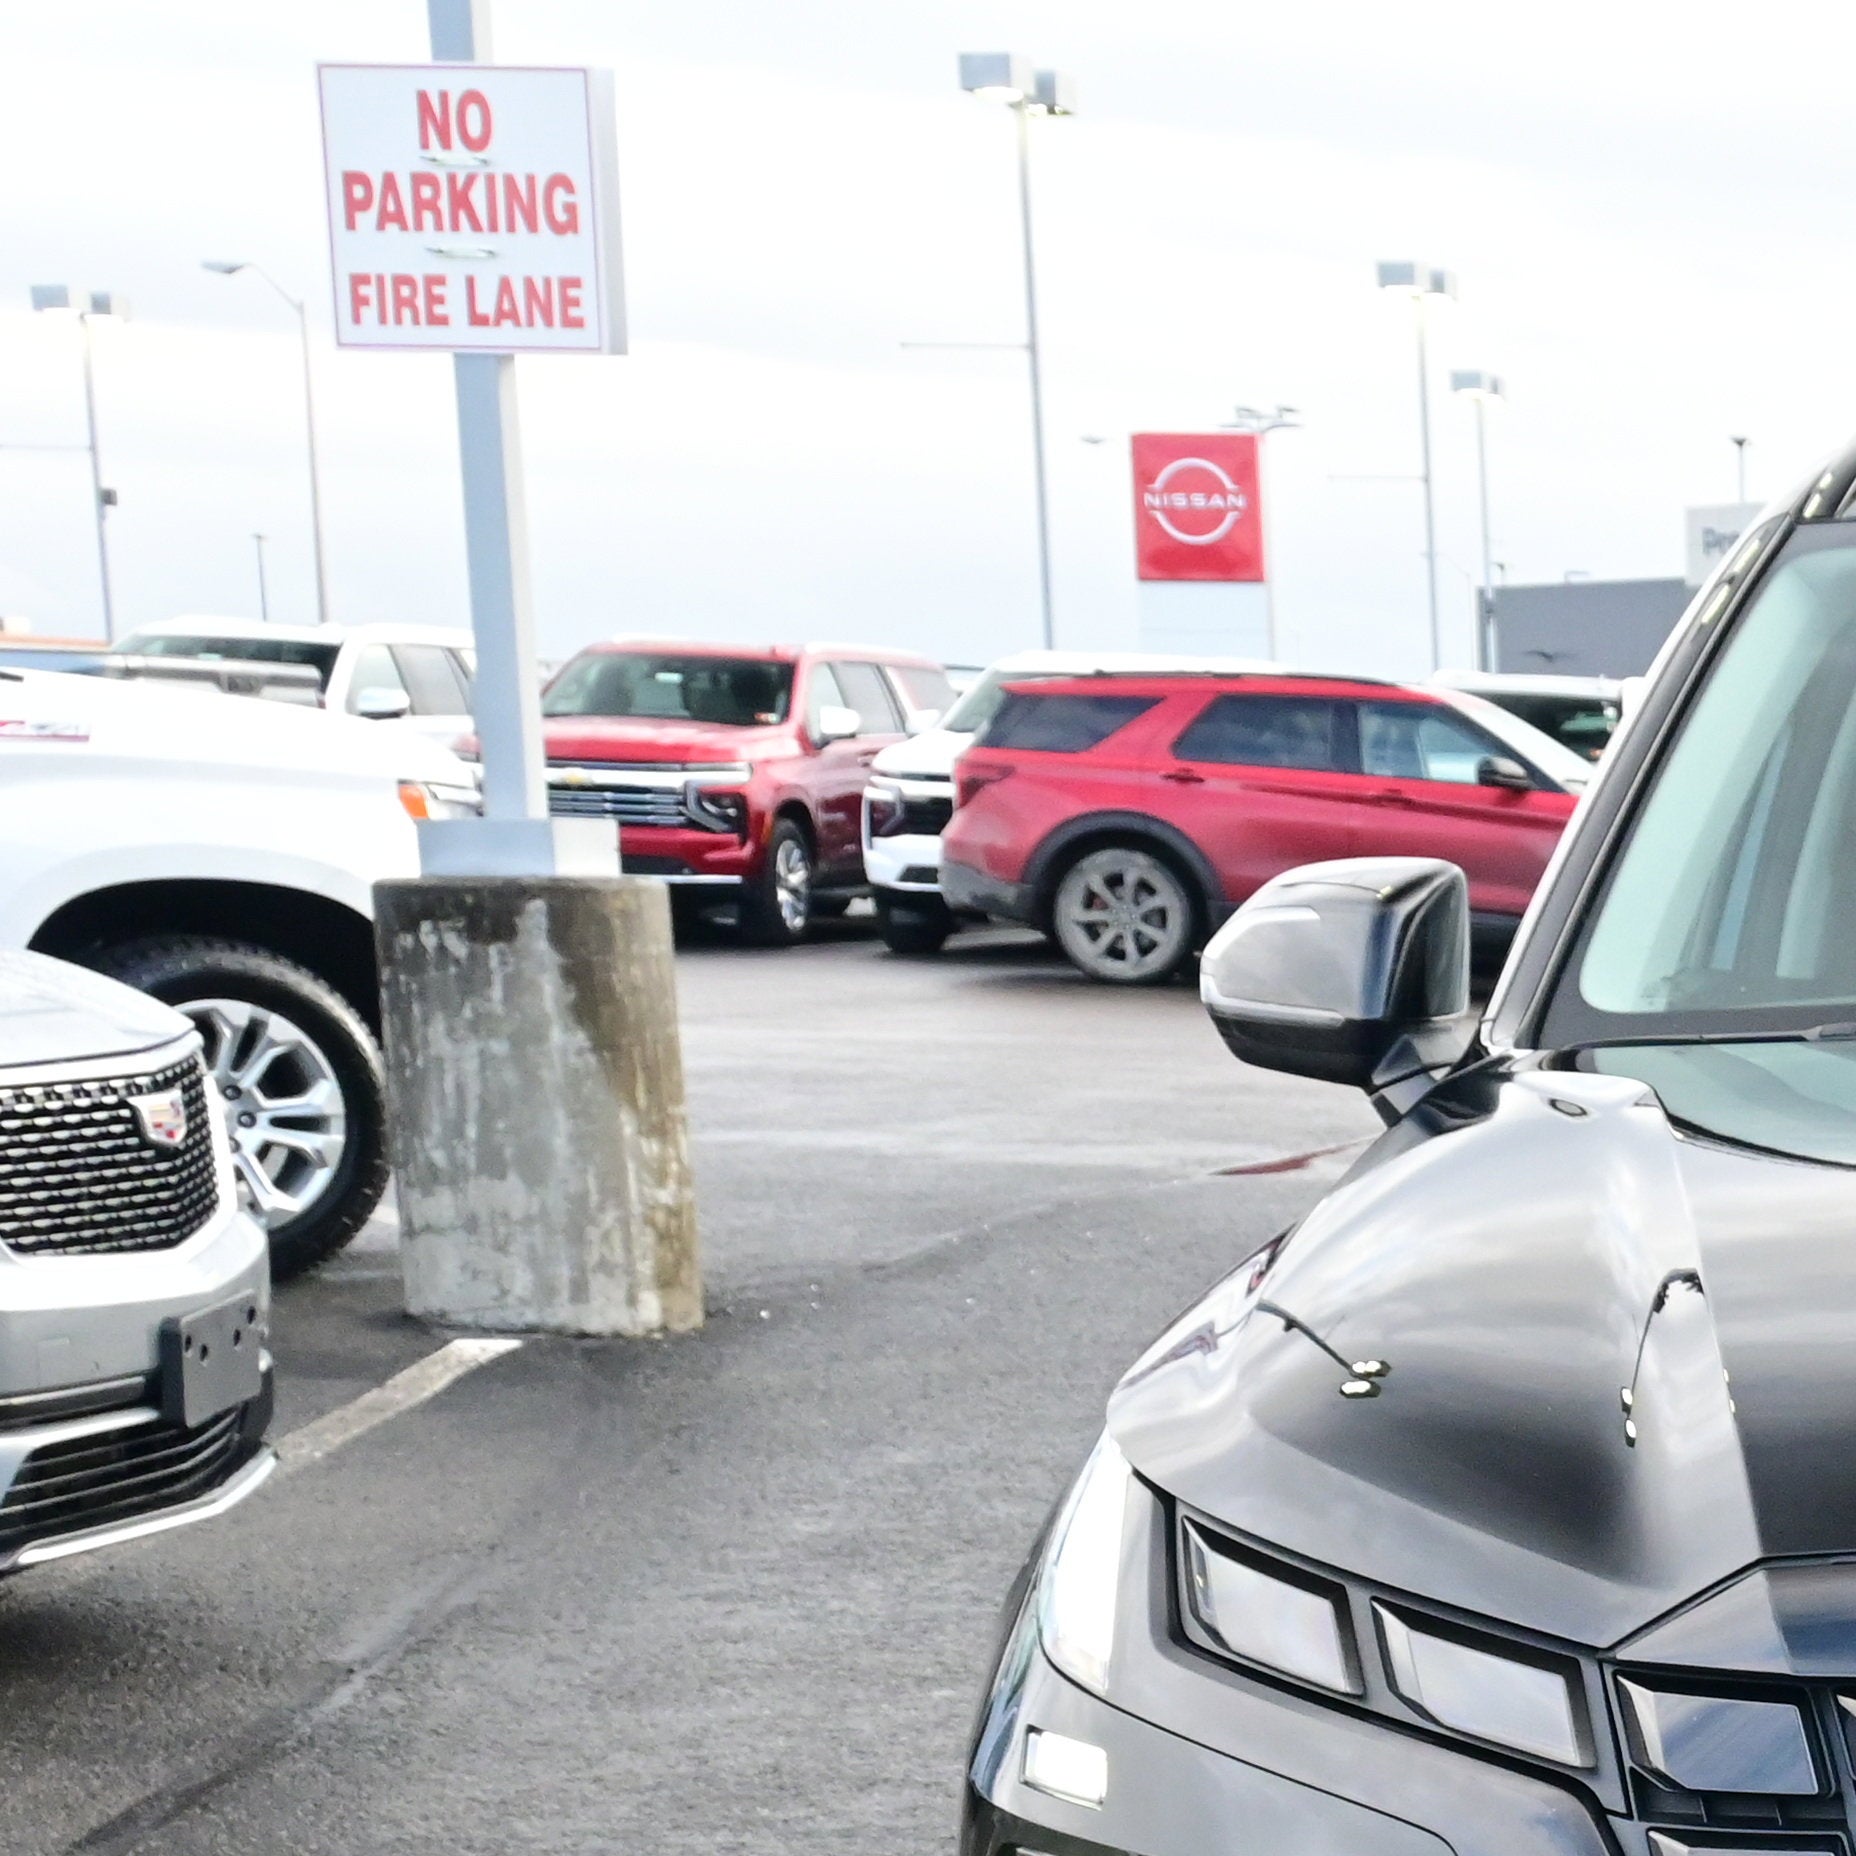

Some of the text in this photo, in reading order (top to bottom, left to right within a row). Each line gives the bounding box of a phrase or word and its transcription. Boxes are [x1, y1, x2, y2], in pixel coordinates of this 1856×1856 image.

[416, 88, 492, 153] NO
[341, 169, 580, 236] PARKING
[349, 272, 586, 329] FIRE LANE
[1143, 491, 1248, 510] NISSAN
